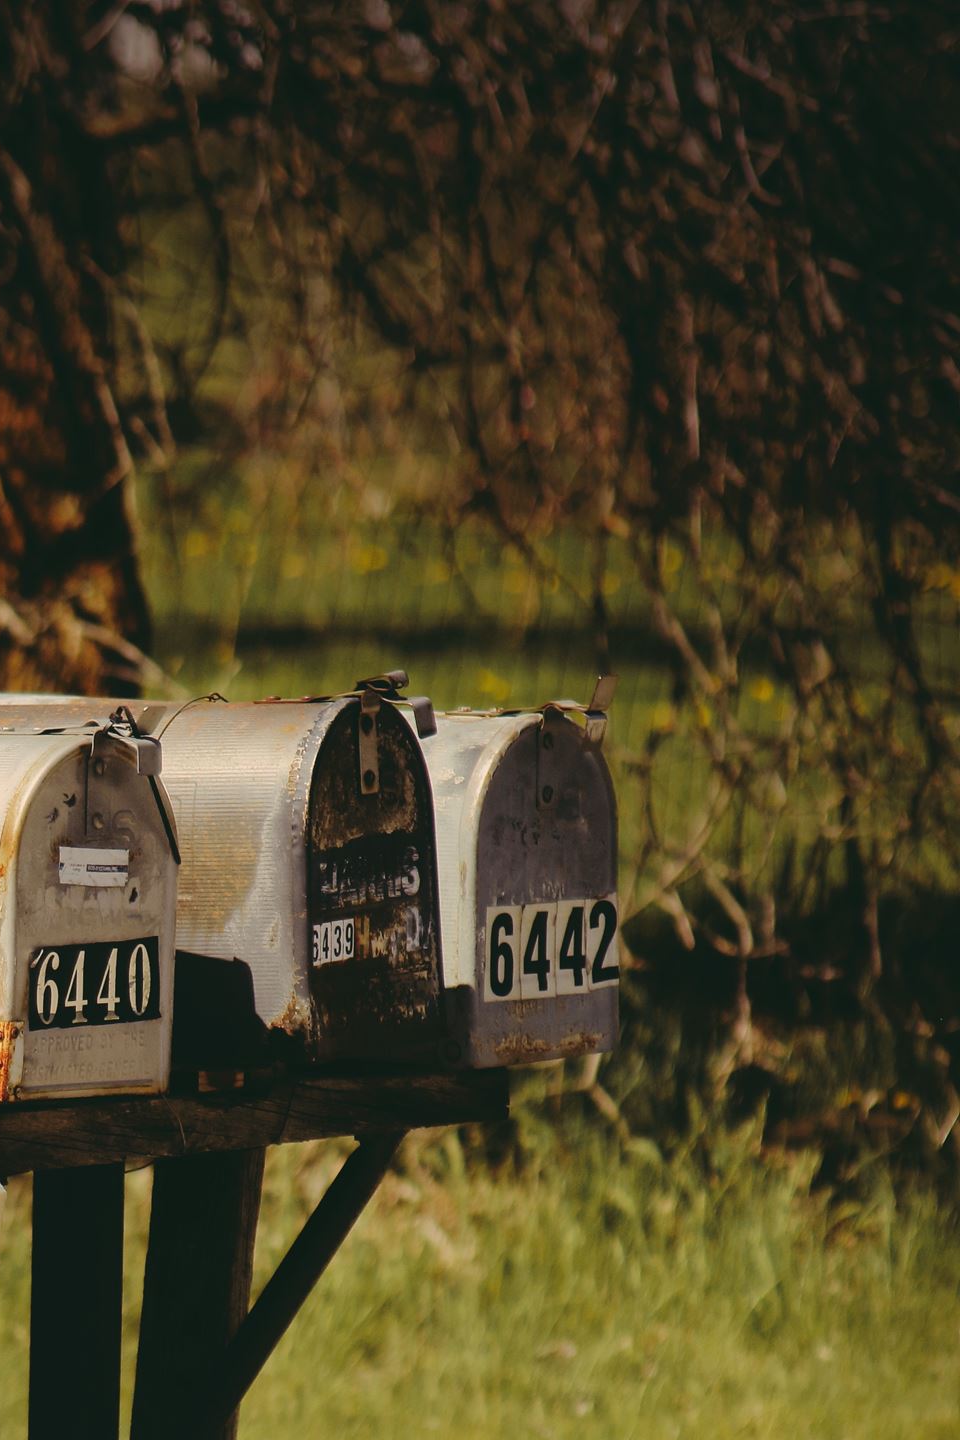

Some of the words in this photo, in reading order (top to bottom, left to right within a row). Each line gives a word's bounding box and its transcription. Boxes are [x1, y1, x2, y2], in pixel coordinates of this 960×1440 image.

[36, 943, 151, 1025] 6440
[312, 923, 354, 963] 6439
[490, 900, 620, 997] 6442
